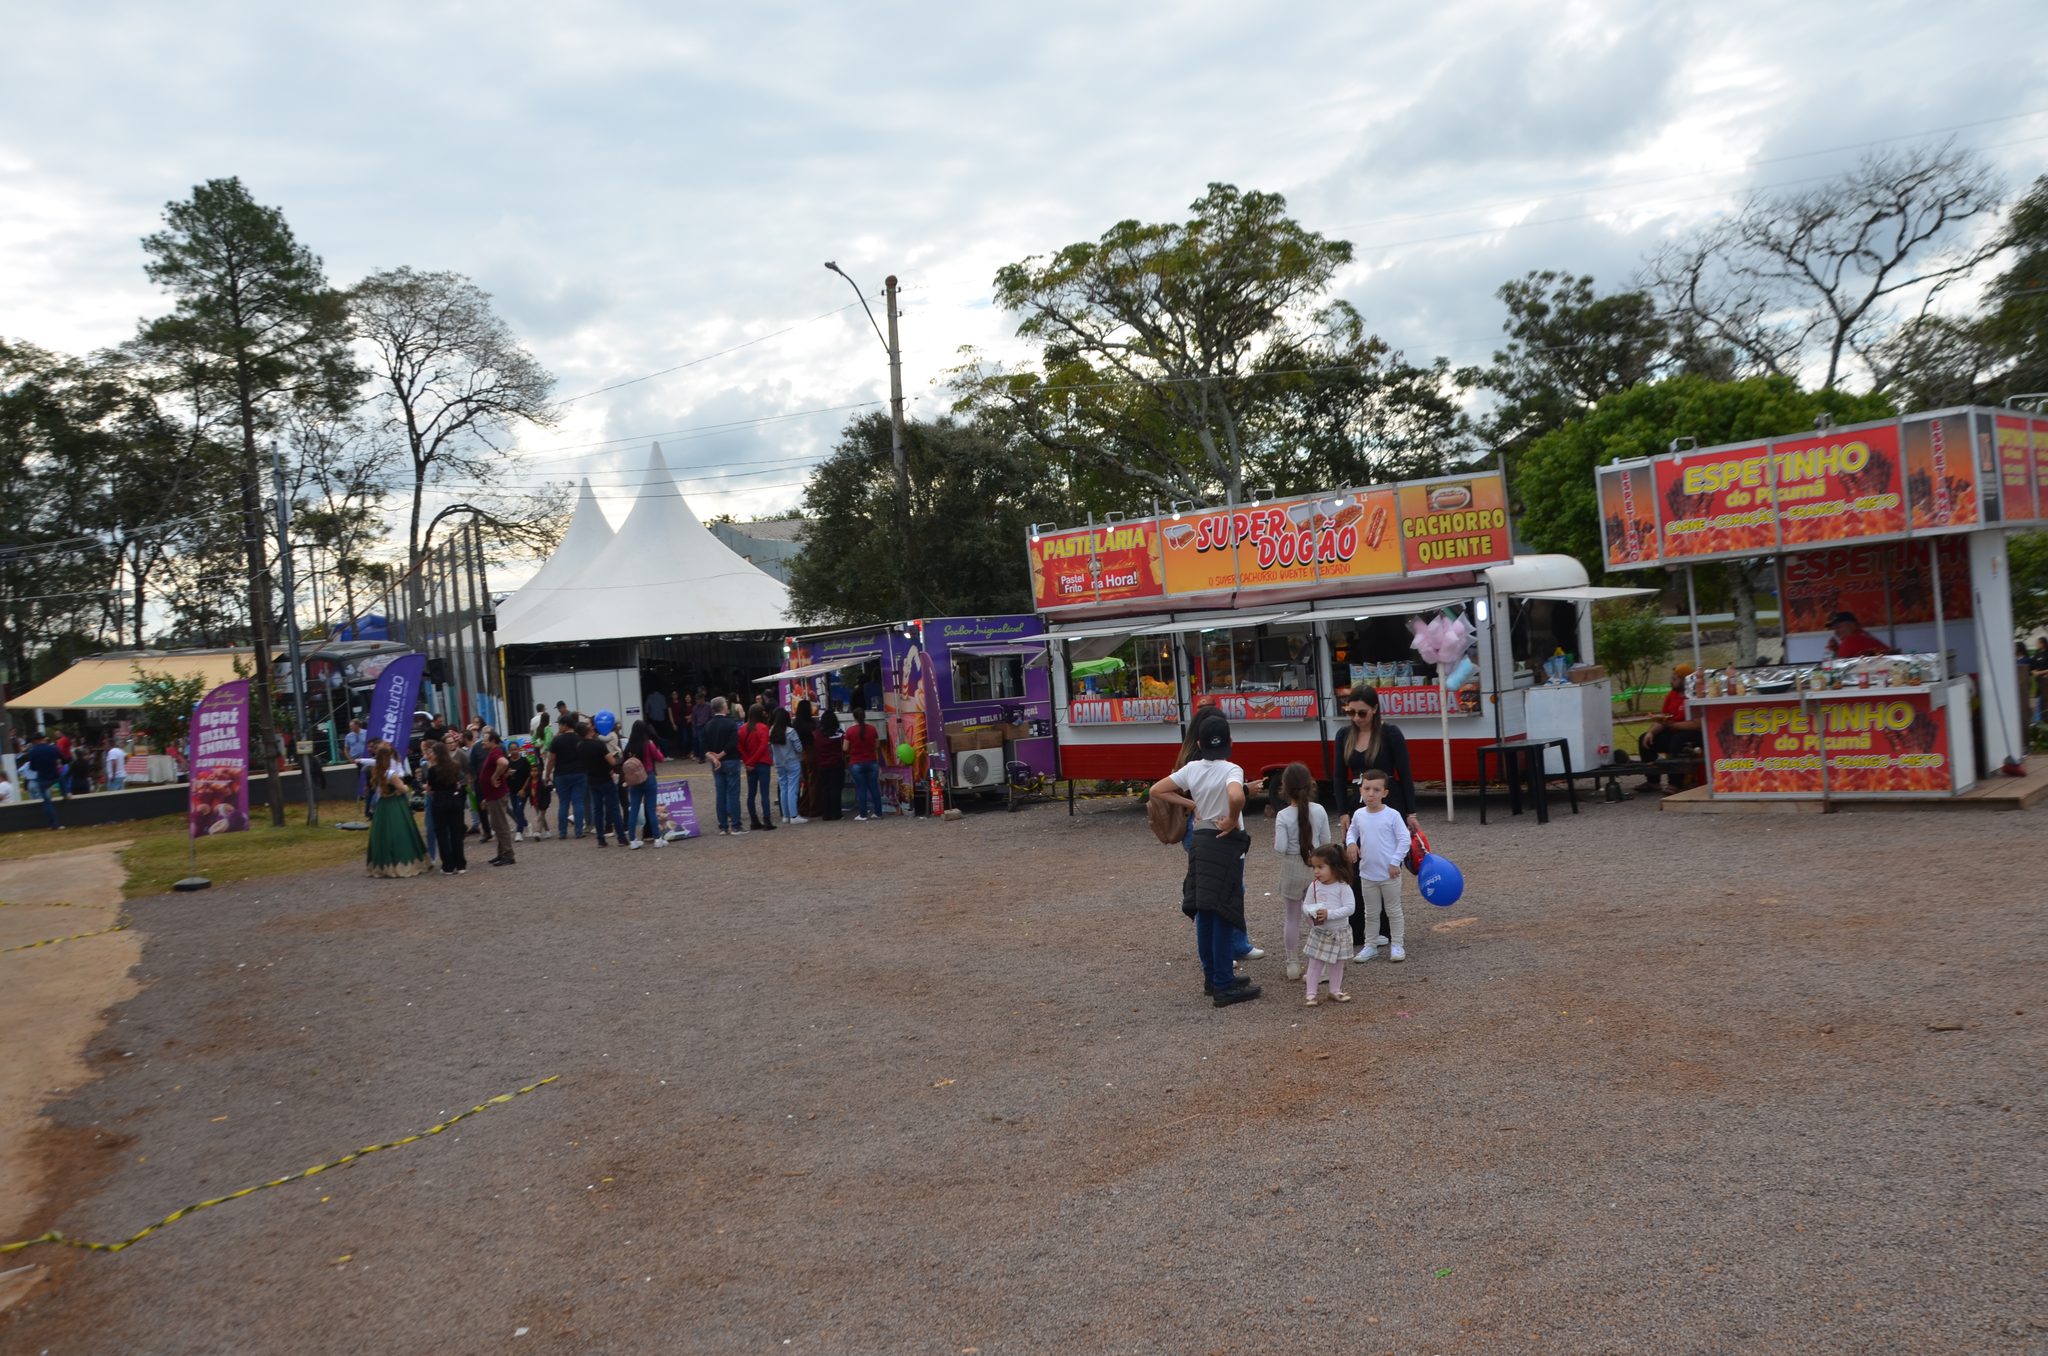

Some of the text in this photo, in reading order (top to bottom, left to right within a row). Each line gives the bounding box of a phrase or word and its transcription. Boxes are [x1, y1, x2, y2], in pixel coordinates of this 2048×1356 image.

[1683, 441, 1870, 495] ESPETINHO
[1726, 489, 1752, 508] do
[1402, 508, 1505, 539] CACHORRO
[1664, 517, 1708, 535] CARNE
[1787, 499, 1846, 521] FRANGO
[1853, 492, 1900, 512] MISTO
[1196, 508, 1287, 550] SUPER
[1043, 527, 1146, 561] PASTELARIA
[1258, 519, 1358, 568] DOGÃO
[1418, 535, 1493, 564] QUENTE
[1061, 573, 1085, 585] Pastel
[1105, 571, 1138, 587] Hora!
[1215, 573, 1238, 586] SUPER
[1239, 570, 1278, 583] CACHORRO
[1280, 567, 1308, 580] QUENTE
[1065, 584, 1083, 594] Frito
[944, 624, 973, 637] Sabor
[382, 675, 404, 743] chêturbo
[1122, 699, 1177, 717] BATATAS
[1221, 698, 1247, 720] XIS
[1274, 695, 1314, 707] CACHORRO
[1378, 691, 1459, 714] NCHERA
[199, 707, 239, 728] AÇAÍ
[1073, 702, 1112, 723] CAIXA
[1281, 706, 1309, 718] QUENTE
[1733, 701, 1915, 736] ESPETINHO
[1775, 733, 1799, 751] do
[1714, 758, 1757, 772] CARNE
[1833, 754, 1891, 769] FRANGO
[1898, 753, 1944, 768] MISTO
